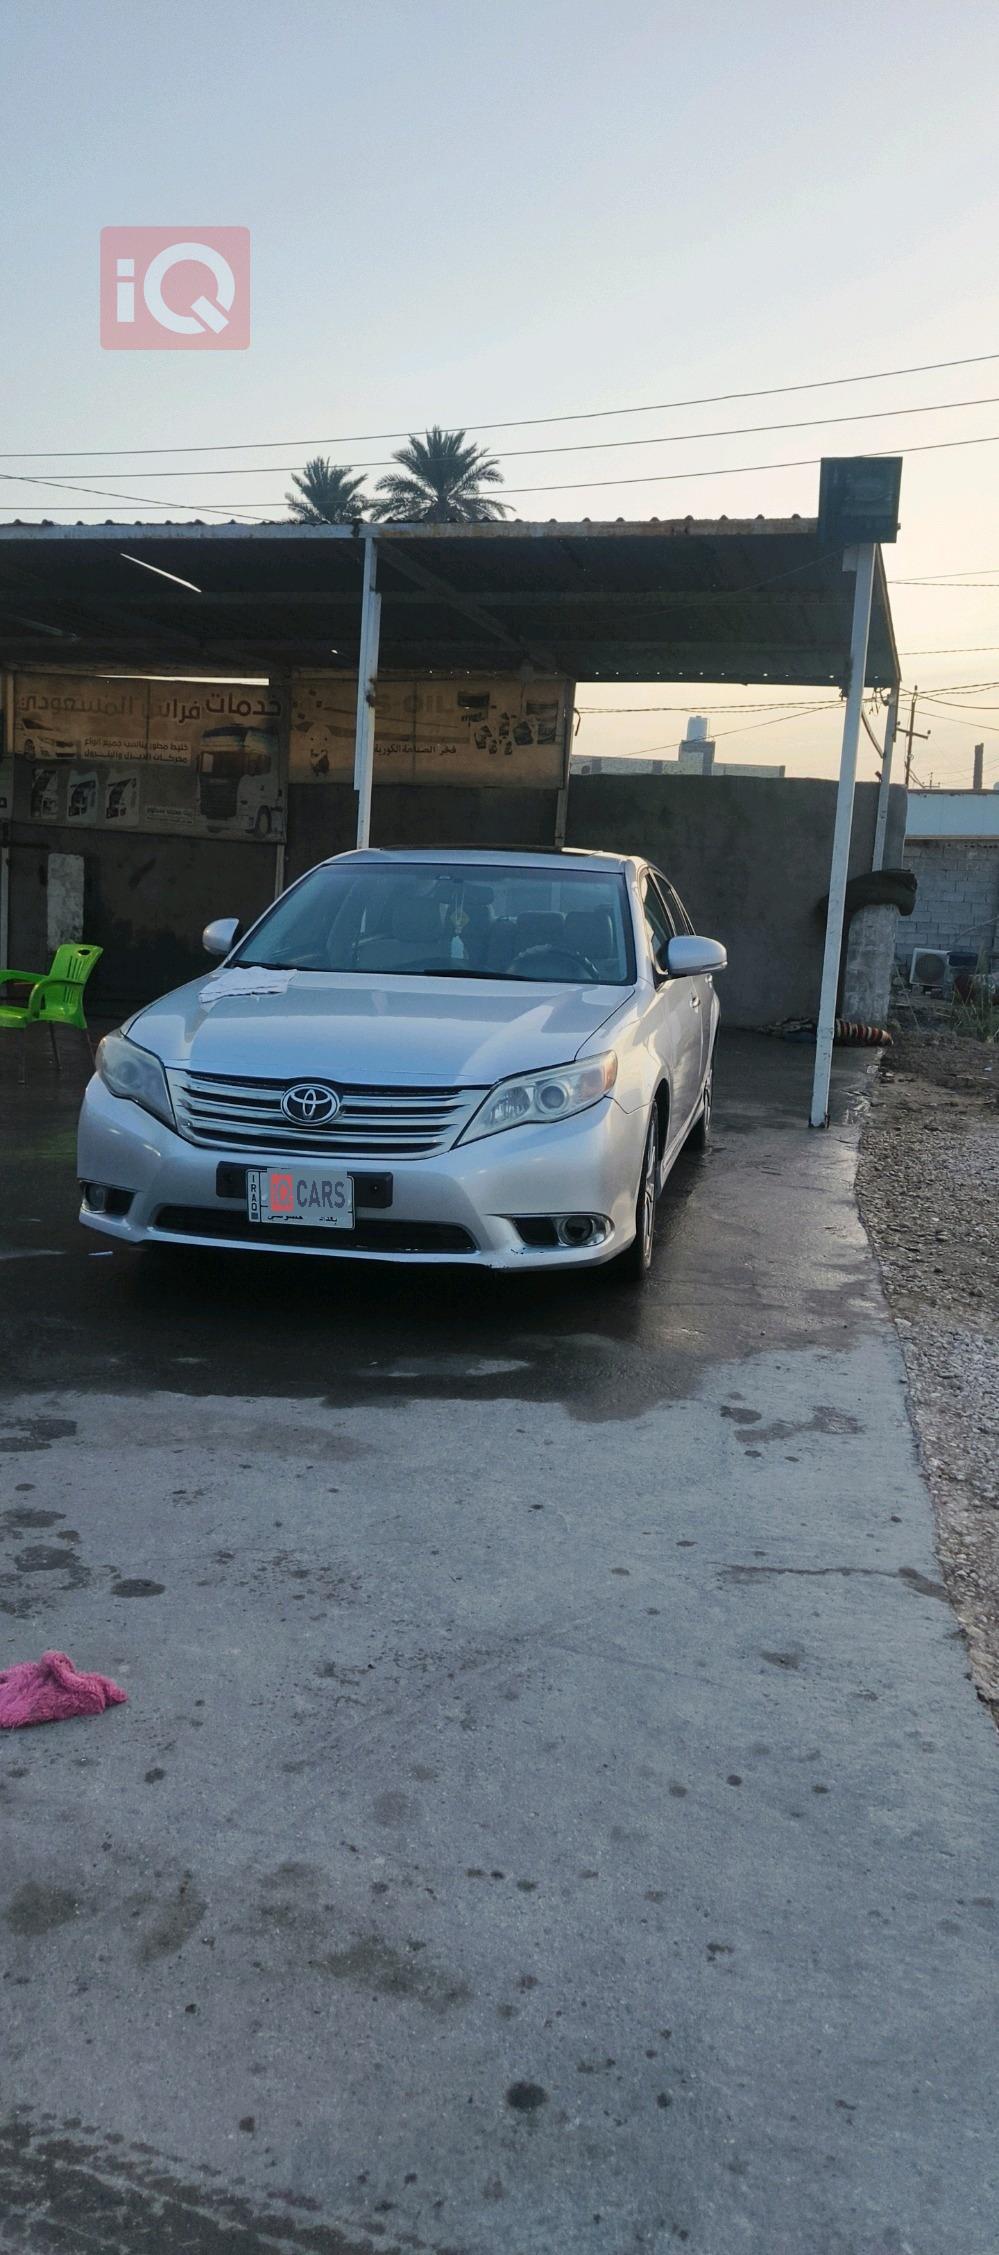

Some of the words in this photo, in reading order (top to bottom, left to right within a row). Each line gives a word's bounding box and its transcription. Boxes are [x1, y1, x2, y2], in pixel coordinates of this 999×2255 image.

[17, 695, 133, 716] المسعودي
[206, 692, 281, 717] خدمات
[440, 744, 457, 756] فخر
